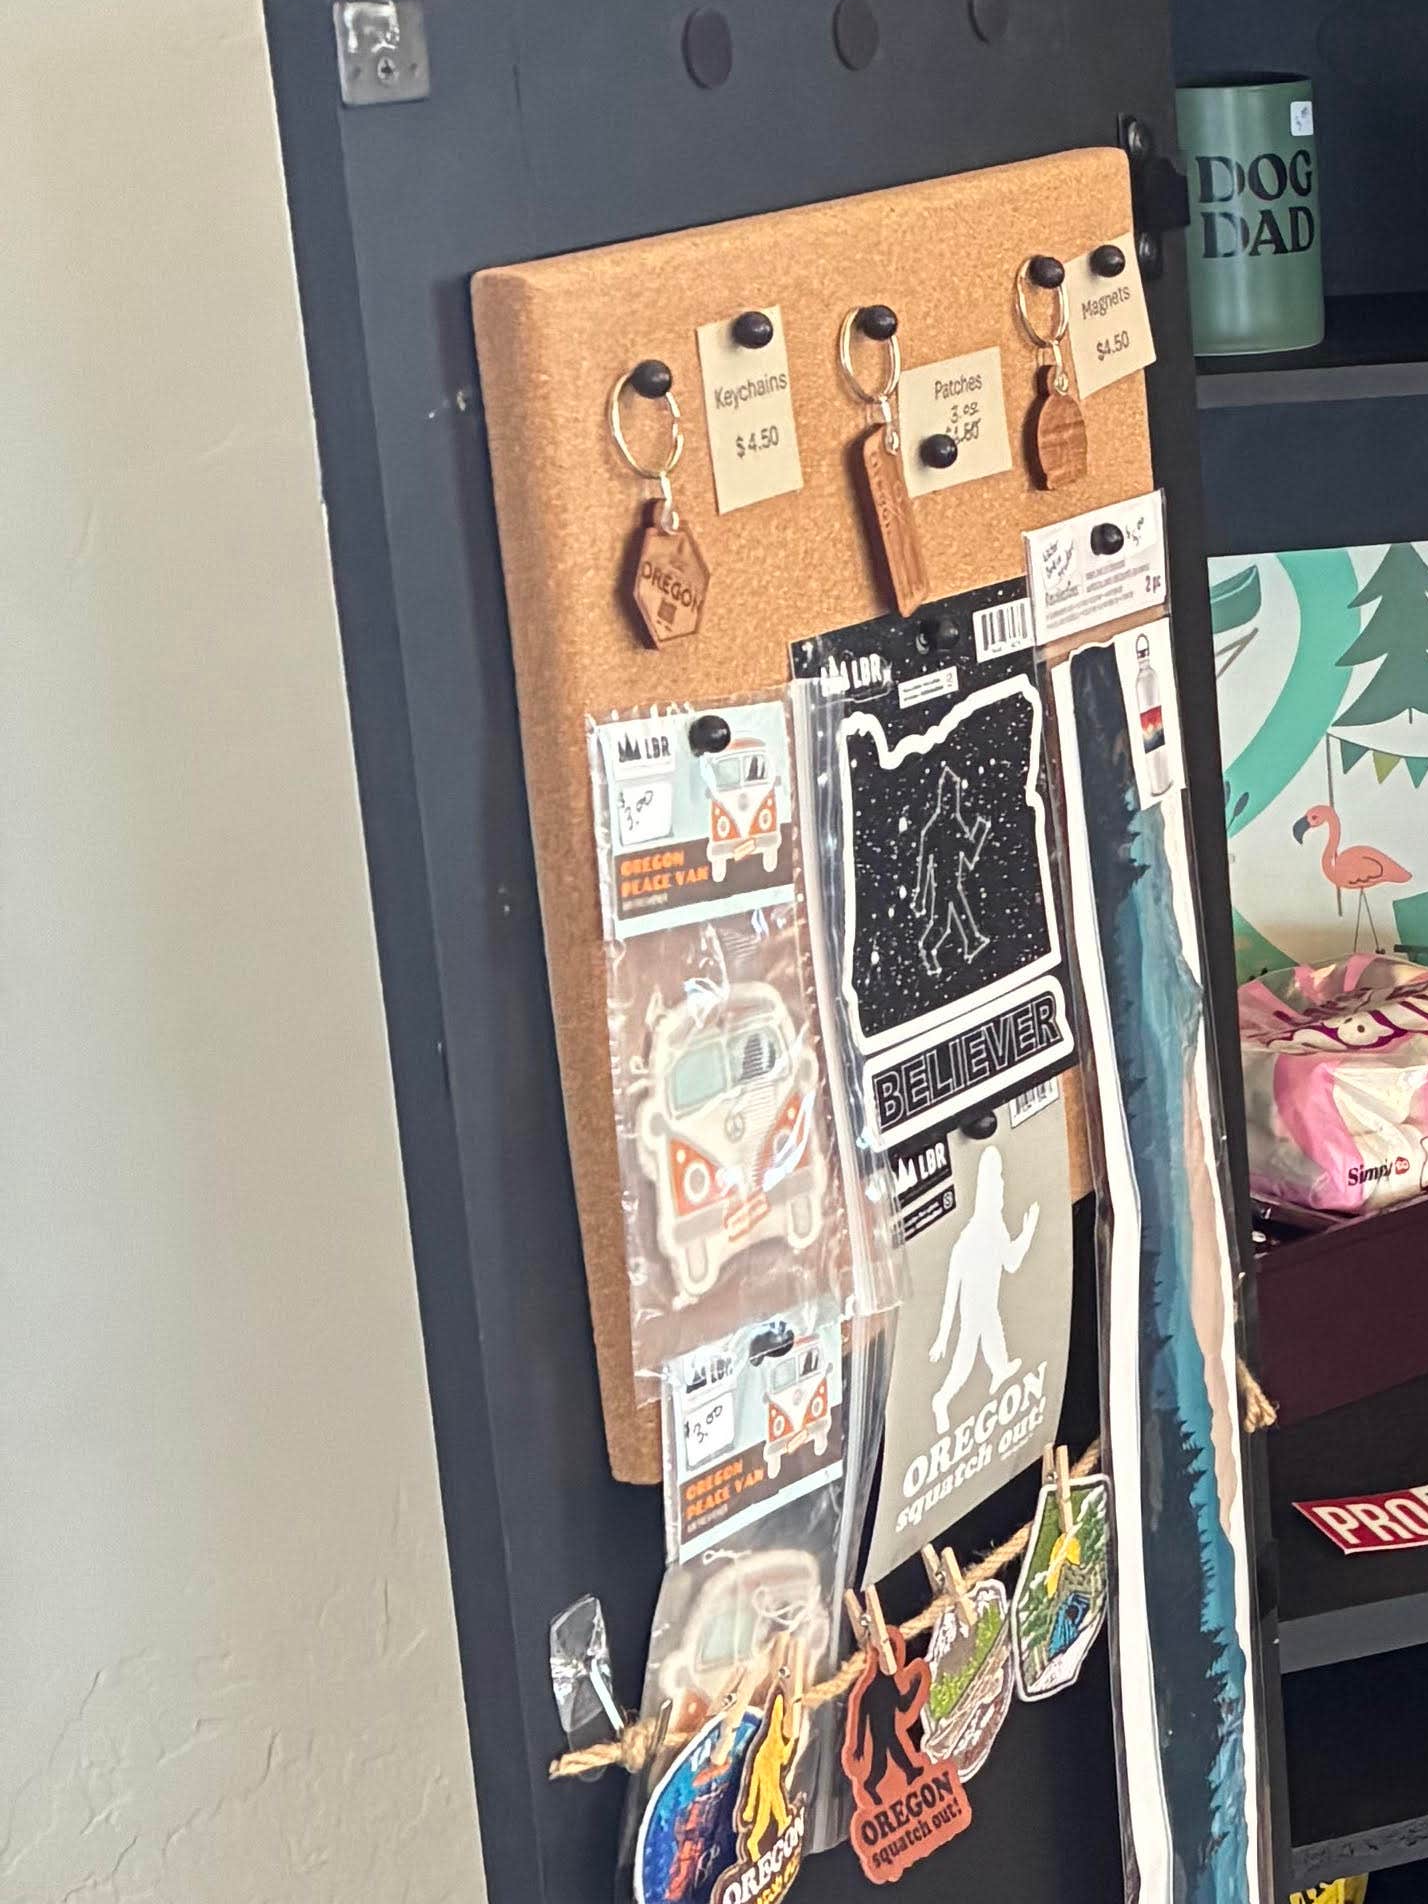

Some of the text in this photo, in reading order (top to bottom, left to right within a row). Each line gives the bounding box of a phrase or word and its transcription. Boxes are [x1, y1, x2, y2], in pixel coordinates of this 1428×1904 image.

[1195, 148, 1314, 205] DOG
[1201, 205, 1315, 260] DAD
[1080, 286, 1132, 320] Magnets
[1096, 338, 1130, 361] $4.50
[713, 372, 789, 410] Keychains
[934, 373, 983, 400] Patches
[735, 425, 780, 459] $4.50
[852, 652, 884, 689] LBR
[644, 734, 672, 759] LBR
[620, 849, 685, 876] OREGON
[675, 864, 710, 887] VAN
[874, 994, 1065, 1130] BELIEVER
[918, 1142, 948, 1179] LBR
[902, 1360, 1048, 1498] OREGON
[685, 1458, 744, 1502] OREGON
[735, 1468, 765, 1494] VAN
[894, 1396, 1047, 1534] squatch out!
[860, 1771, 955, 1846] OREGON
[871, 1798, 965, 1870] squatch out!
